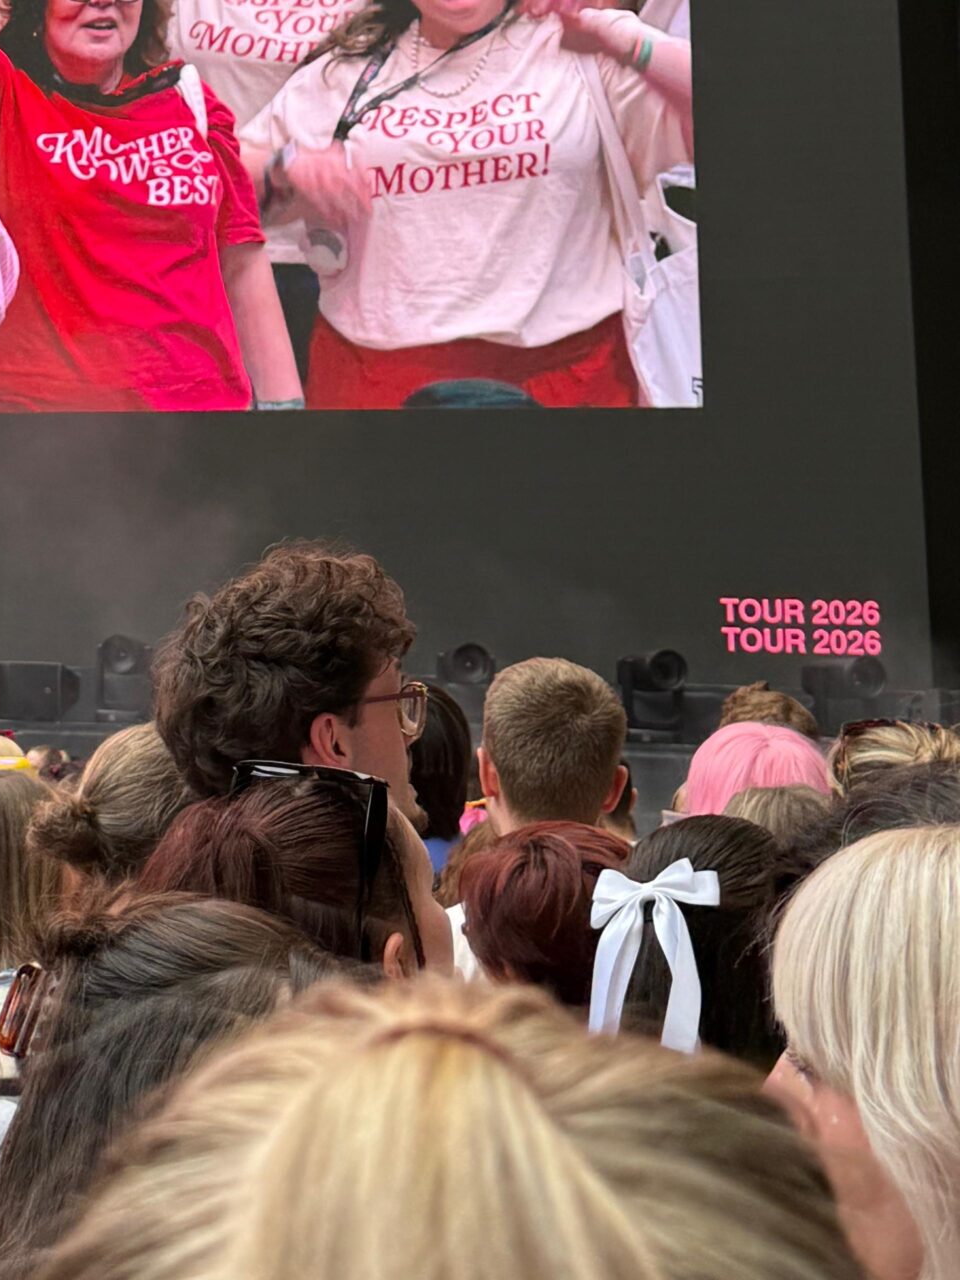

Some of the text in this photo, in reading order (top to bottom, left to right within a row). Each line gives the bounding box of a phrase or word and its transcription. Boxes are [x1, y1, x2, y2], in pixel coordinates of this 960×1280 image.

[361, 92, 541, 138] RESPECT
[426, 119, 546, 154] YOUR
[370, 143, 551, 199] MOTHER!
[719, 596, 881, 627] TOUR 2026
[720, 626, 882, 657] TOUR 2026
